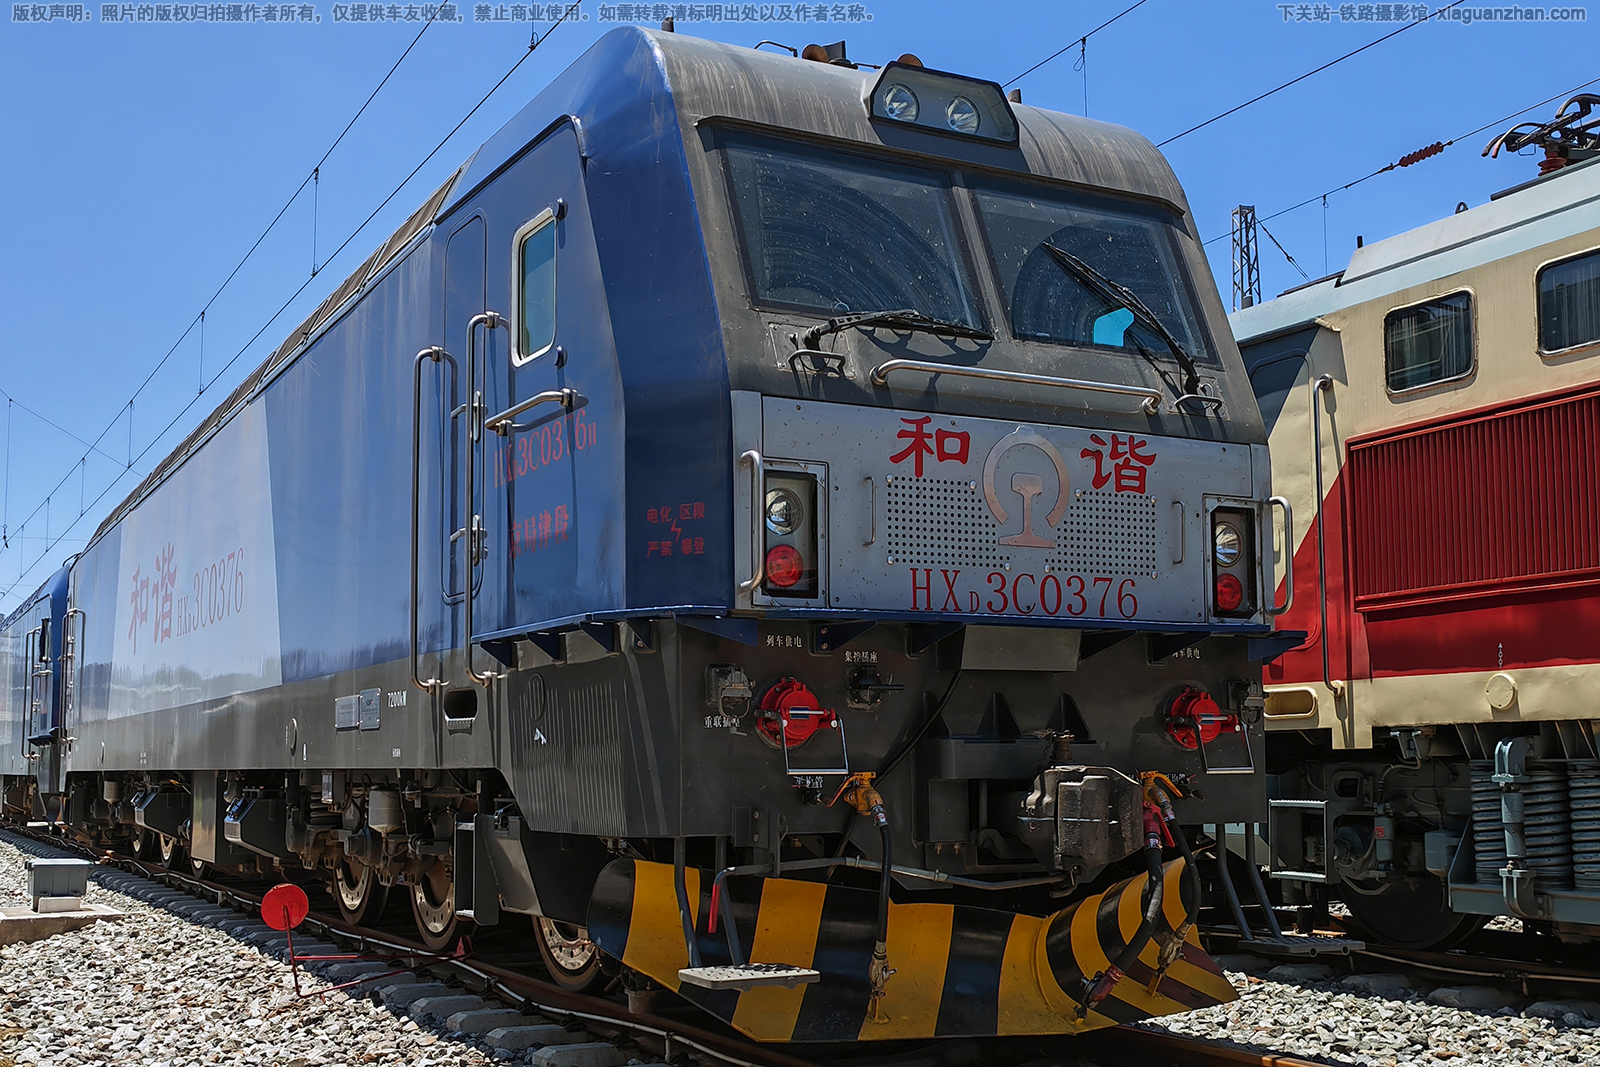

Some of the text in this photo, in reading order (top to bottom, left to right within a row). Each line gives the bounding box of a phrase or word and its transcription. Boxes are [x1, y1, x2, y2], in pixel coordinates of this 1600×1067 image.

[889, 415, 1157, 494] 和 谐
[128, 541, 178, 655] 和谐
[910, 567, 1138, 618] HXD3C0376
[766, 635, 802, 648] 列车供电
